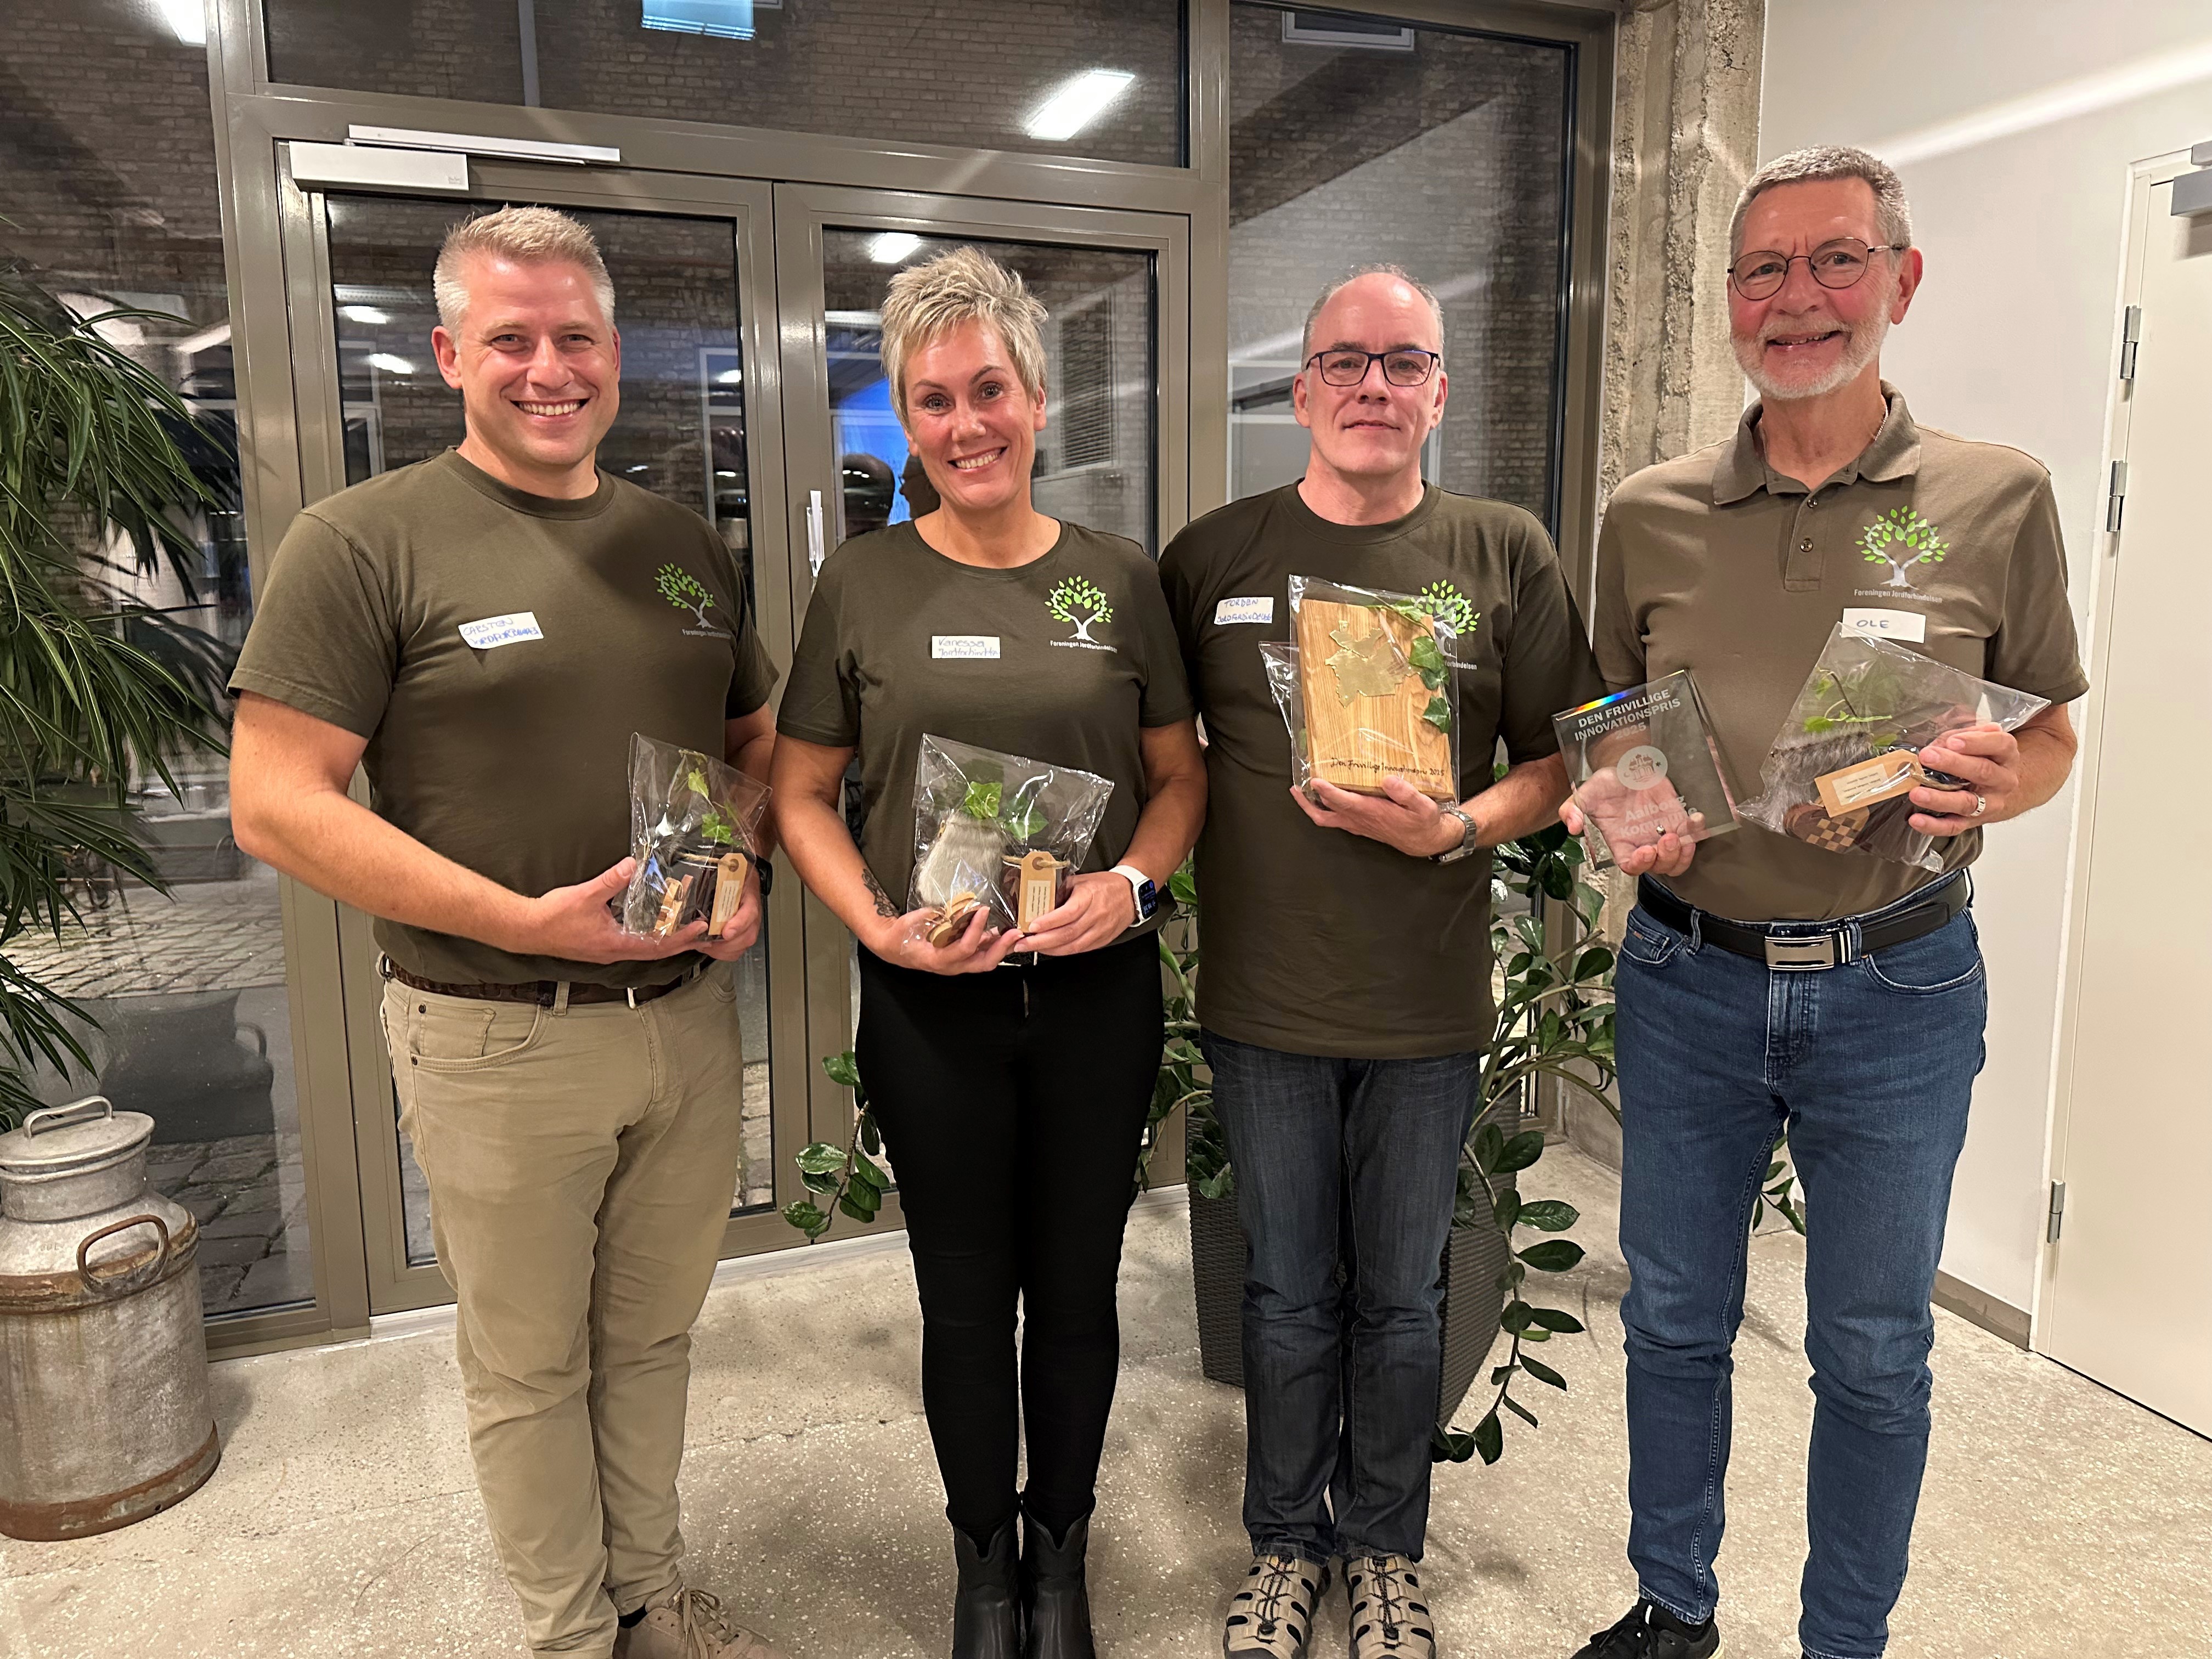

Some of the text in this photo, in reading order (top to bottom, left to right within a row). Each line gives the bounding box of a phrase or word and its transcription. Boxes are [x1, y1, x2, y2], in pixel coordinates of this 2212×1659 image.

[1854, 589, 1943, 603] Foreningen Jordforbindelsen
[463, 617, 514, 636] CARSTEN
[1857, 619, 1889, 629] OLE
[939, 635, 985, 648] Vanessa
[1050, 640, 1079, 648] Foreningen
[1578, 689, 1671, 729] DEN FRIVILLIGE
[1574, 698, 1681, 742] INNOVATIONSPRIS
[1615, 721, 1647, 740] 2025
[1330, 757, 1346, 768] Den
[1429, 768, 1444, 776] 2025
